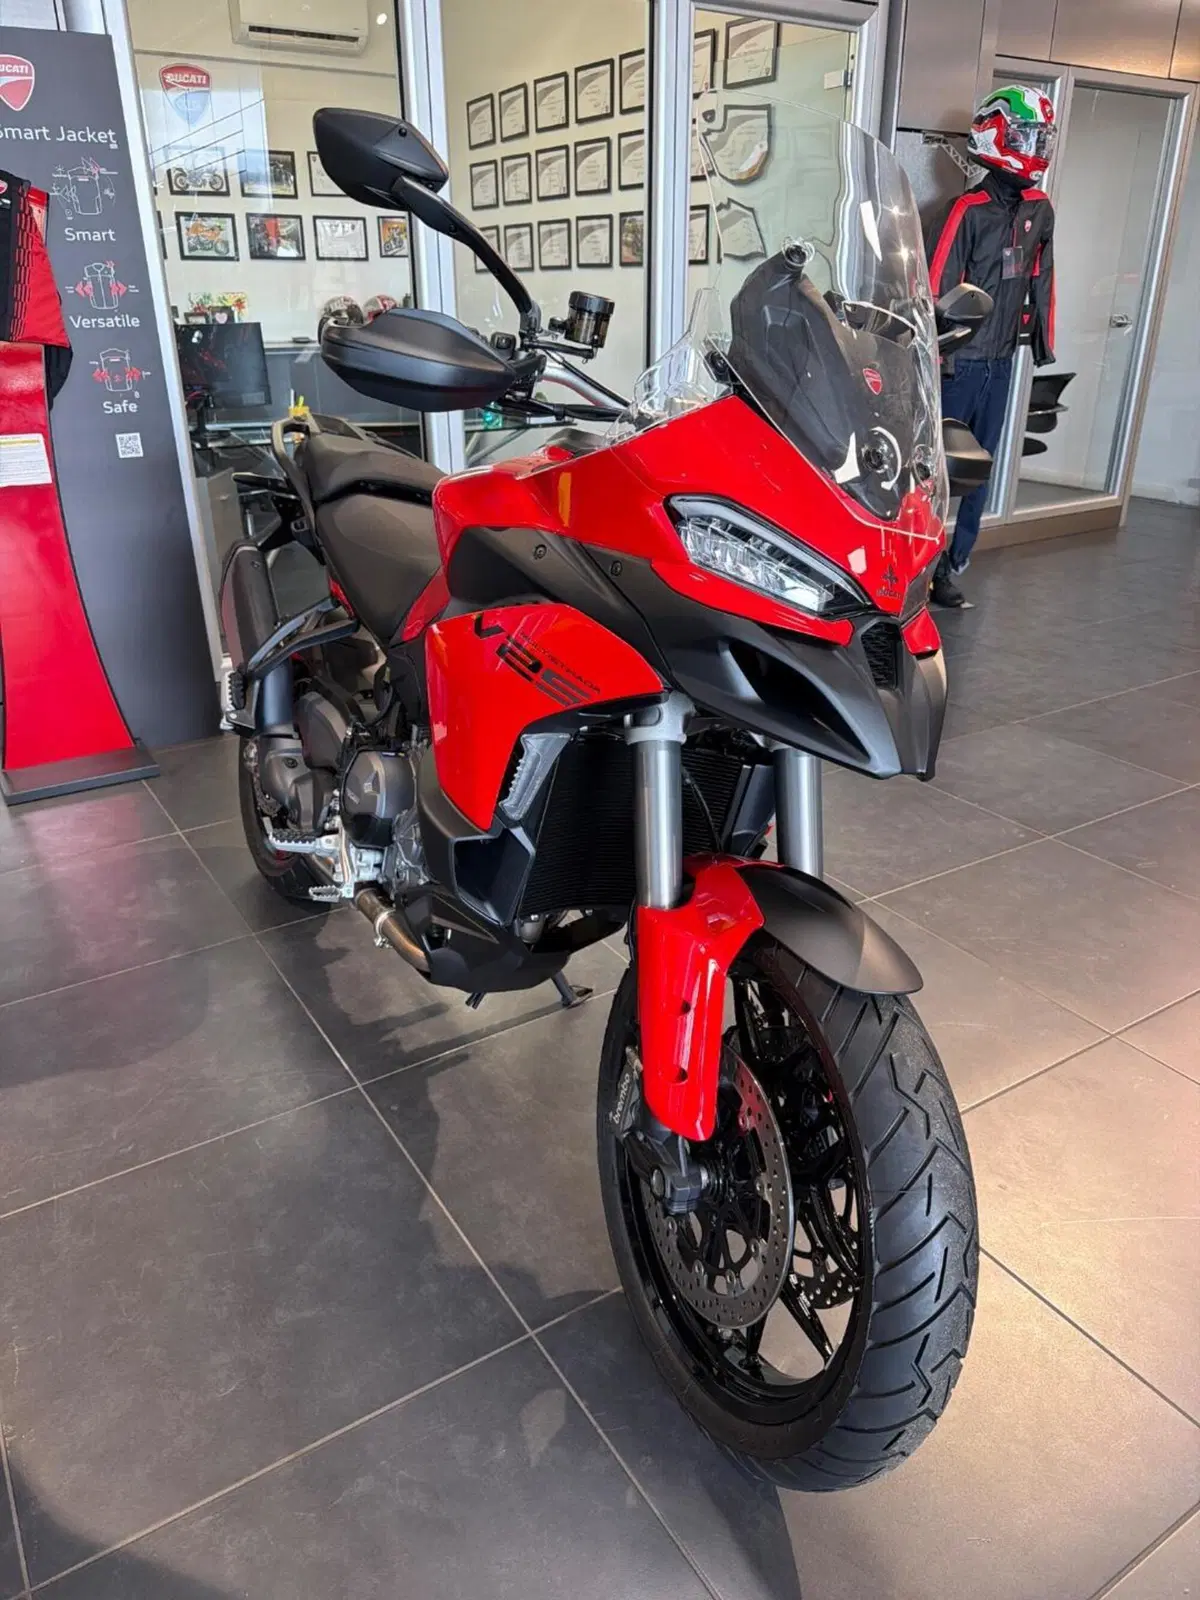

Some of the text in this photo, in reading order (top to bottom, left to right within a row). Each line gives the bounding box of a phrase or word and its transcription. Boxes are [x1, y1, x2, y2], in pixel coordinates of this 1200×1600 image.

[0, 64, 29, 74] UCATI
[164, 73, 207, 84] DUCATI
[56, 126, 117, 143] Jacket
[64, 227, 116, 242] Smart
[69, 314, 141, 329] Versatile
[103, 400, 138, 414] Safe
[613, 1073, 630, 1124] brembo
